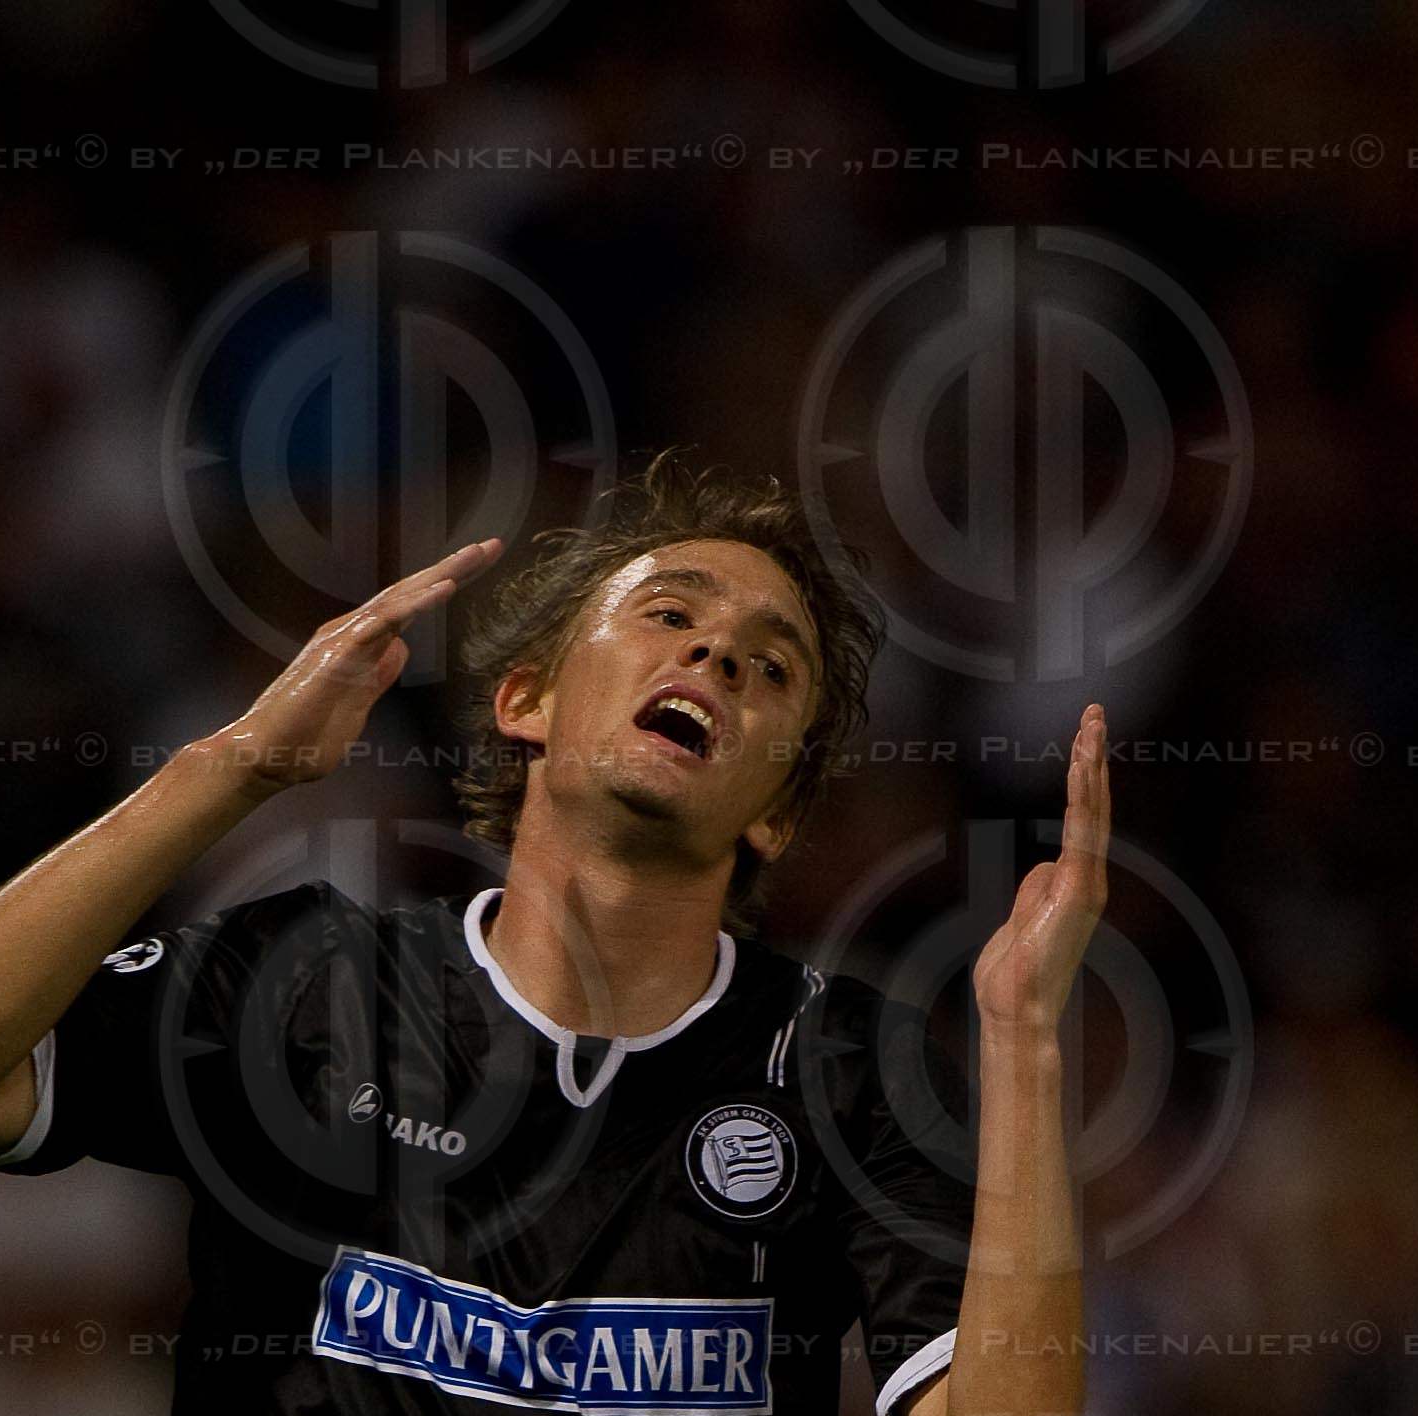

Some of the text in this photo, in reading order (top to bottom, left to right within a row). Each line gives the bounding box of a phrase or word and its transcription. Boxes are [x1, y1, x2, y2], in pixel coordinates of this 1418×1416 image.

[707, 1109, 739, 1127] STURM
[742, 1109, 771, 1124] GRAZ
[346, 1269, 755, 1393] PUNTIGAMER
